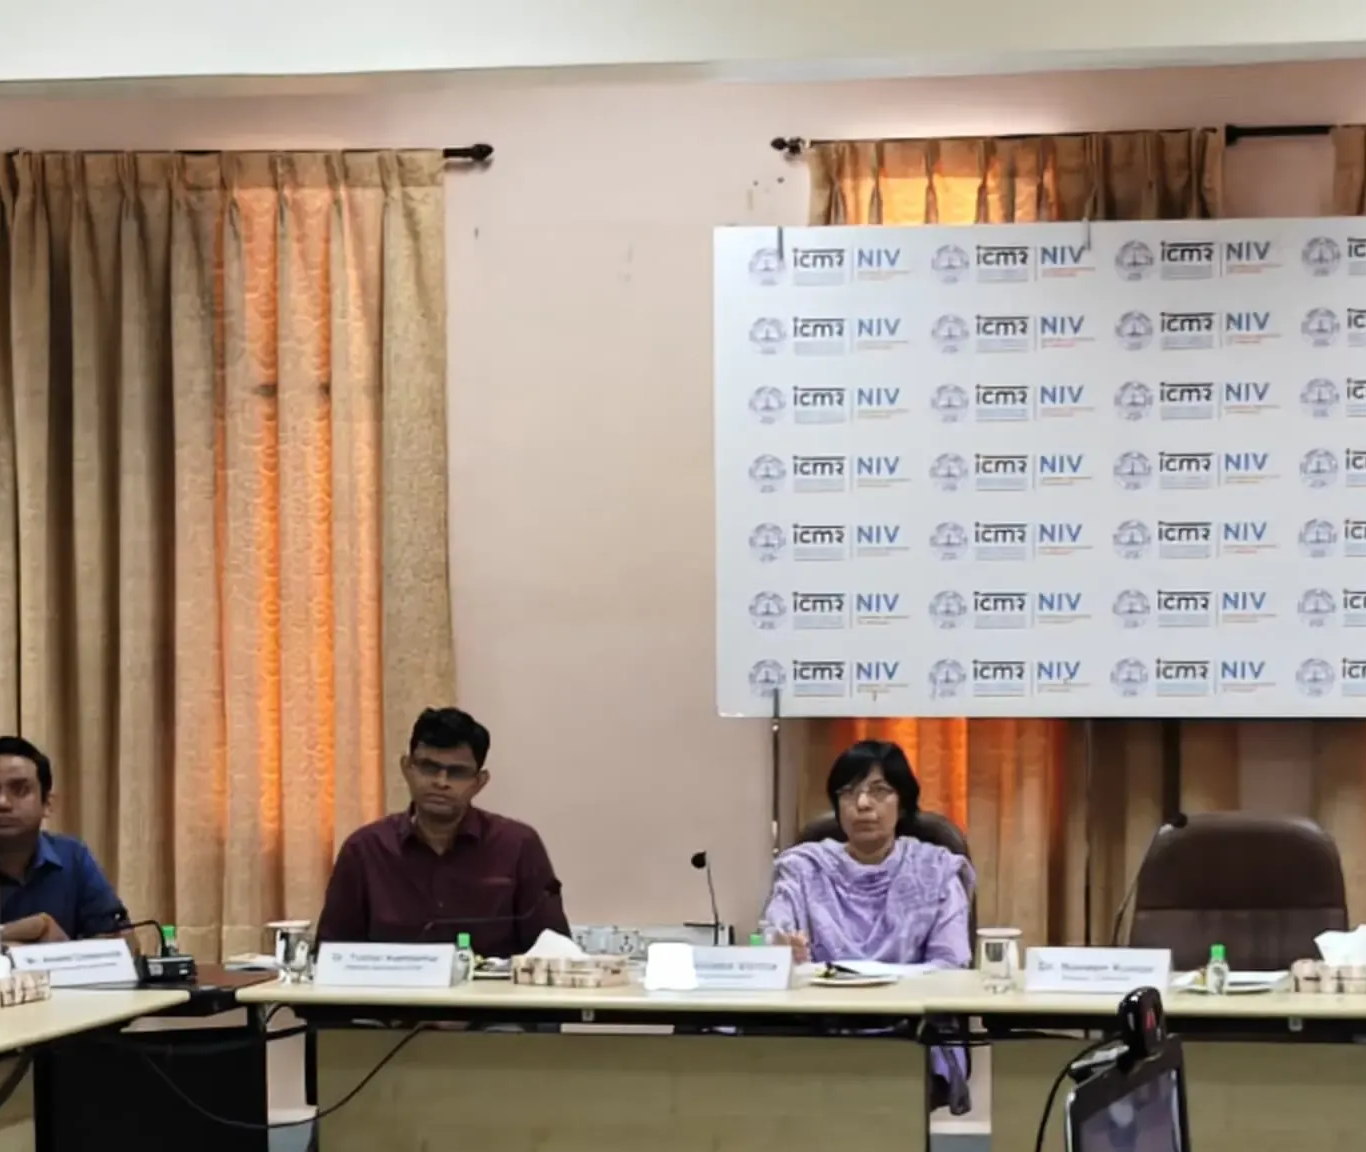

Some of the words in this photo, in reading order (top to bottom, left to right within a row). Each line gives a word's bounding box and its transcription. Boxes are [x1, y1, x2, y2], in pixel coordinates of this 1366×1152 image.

[858, 249, 900, 267] NIV
[1041, 246, 1084, 264] NIV
[1226, 241, 1271, 260] NIV
[858, 318, 900, 337] NIV
[1041, 316, 1084, 334] NIV
[1226, 312, 1270, 331] NIV
[858, 388, 899, 406] NIV
[1040, 386, 1083, 404] NIV
[1226, 383, 1269, 401] NIV
[857, 456, 899, 475] NIV
[1040, 455, 1082, 473] NIV
[1225, 453, 1268, 472] NIV
[857, 525, 900, 544] NIV
[1039, 524, 1082, 542] NIV
[1224, 522, 1267, 541] NIV
[856, 594, 899, 613] NIV
[1039, 593, 1081, 611] NIV
[1223, 592, 1266, 610] NIV
[857, 662, 899, 680] NIV
[1037, 661, 1080, 680] NIV
[1221, 661, 1265, 679] NIV
